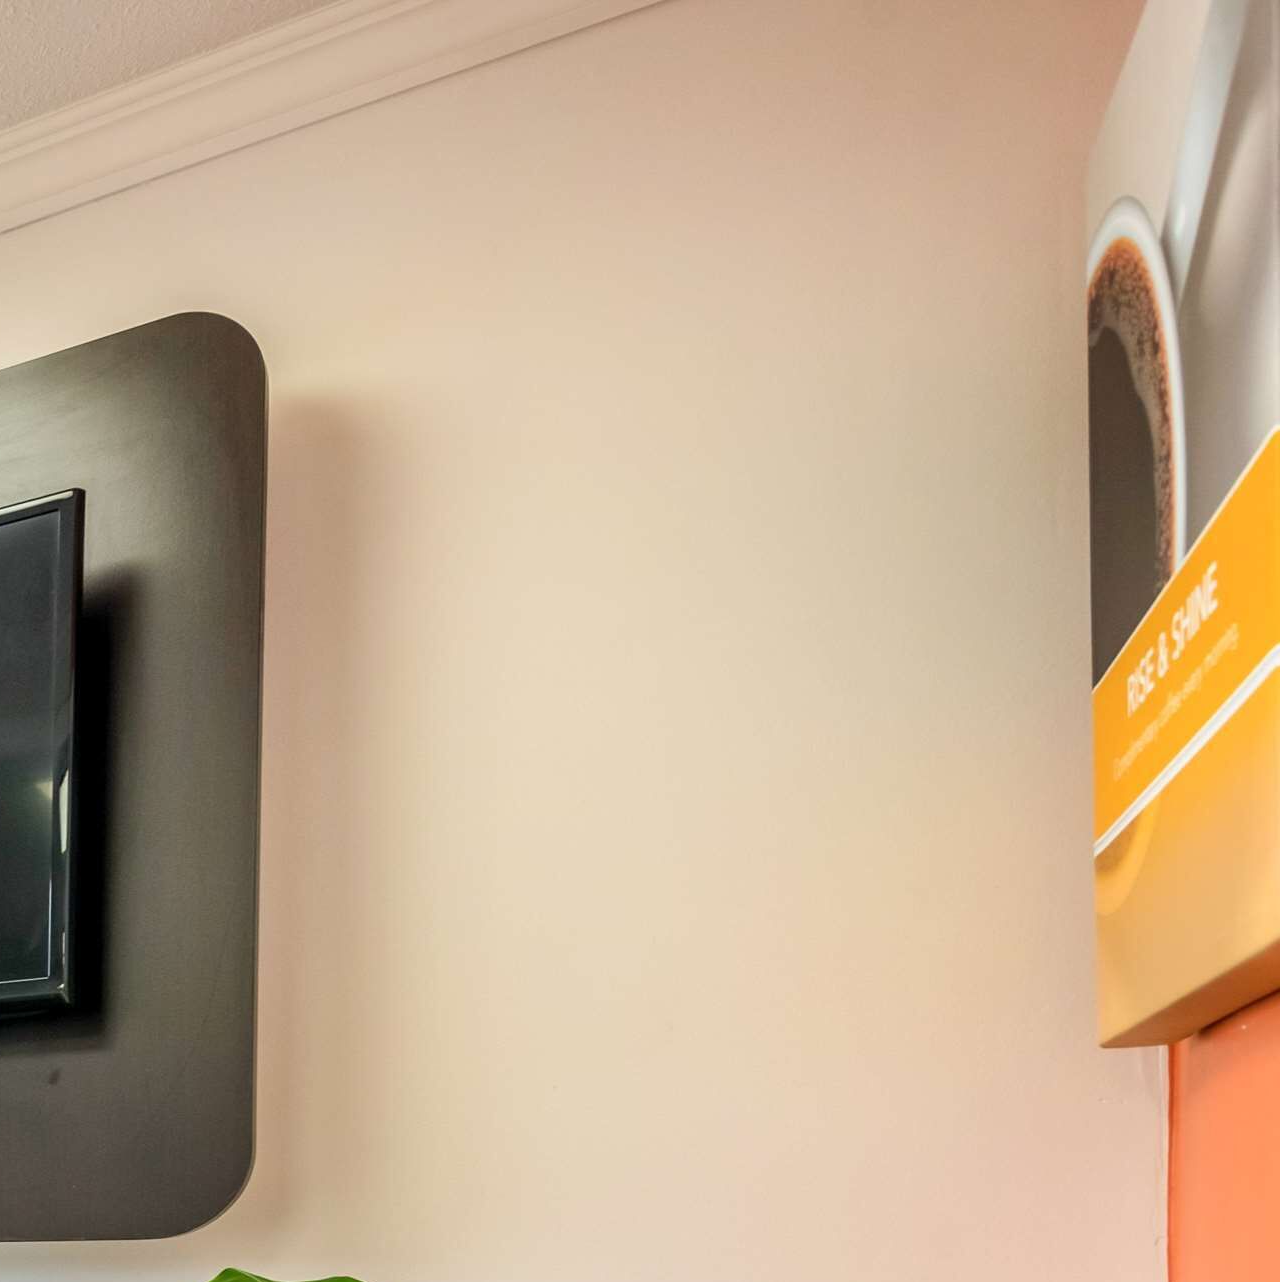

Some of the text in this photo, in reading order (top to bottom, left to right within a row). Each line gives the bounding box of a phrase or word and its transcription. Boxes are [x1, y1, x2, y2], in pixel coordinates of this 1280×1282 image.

[1127, 560, 1218, 718] RISE & SHINE
